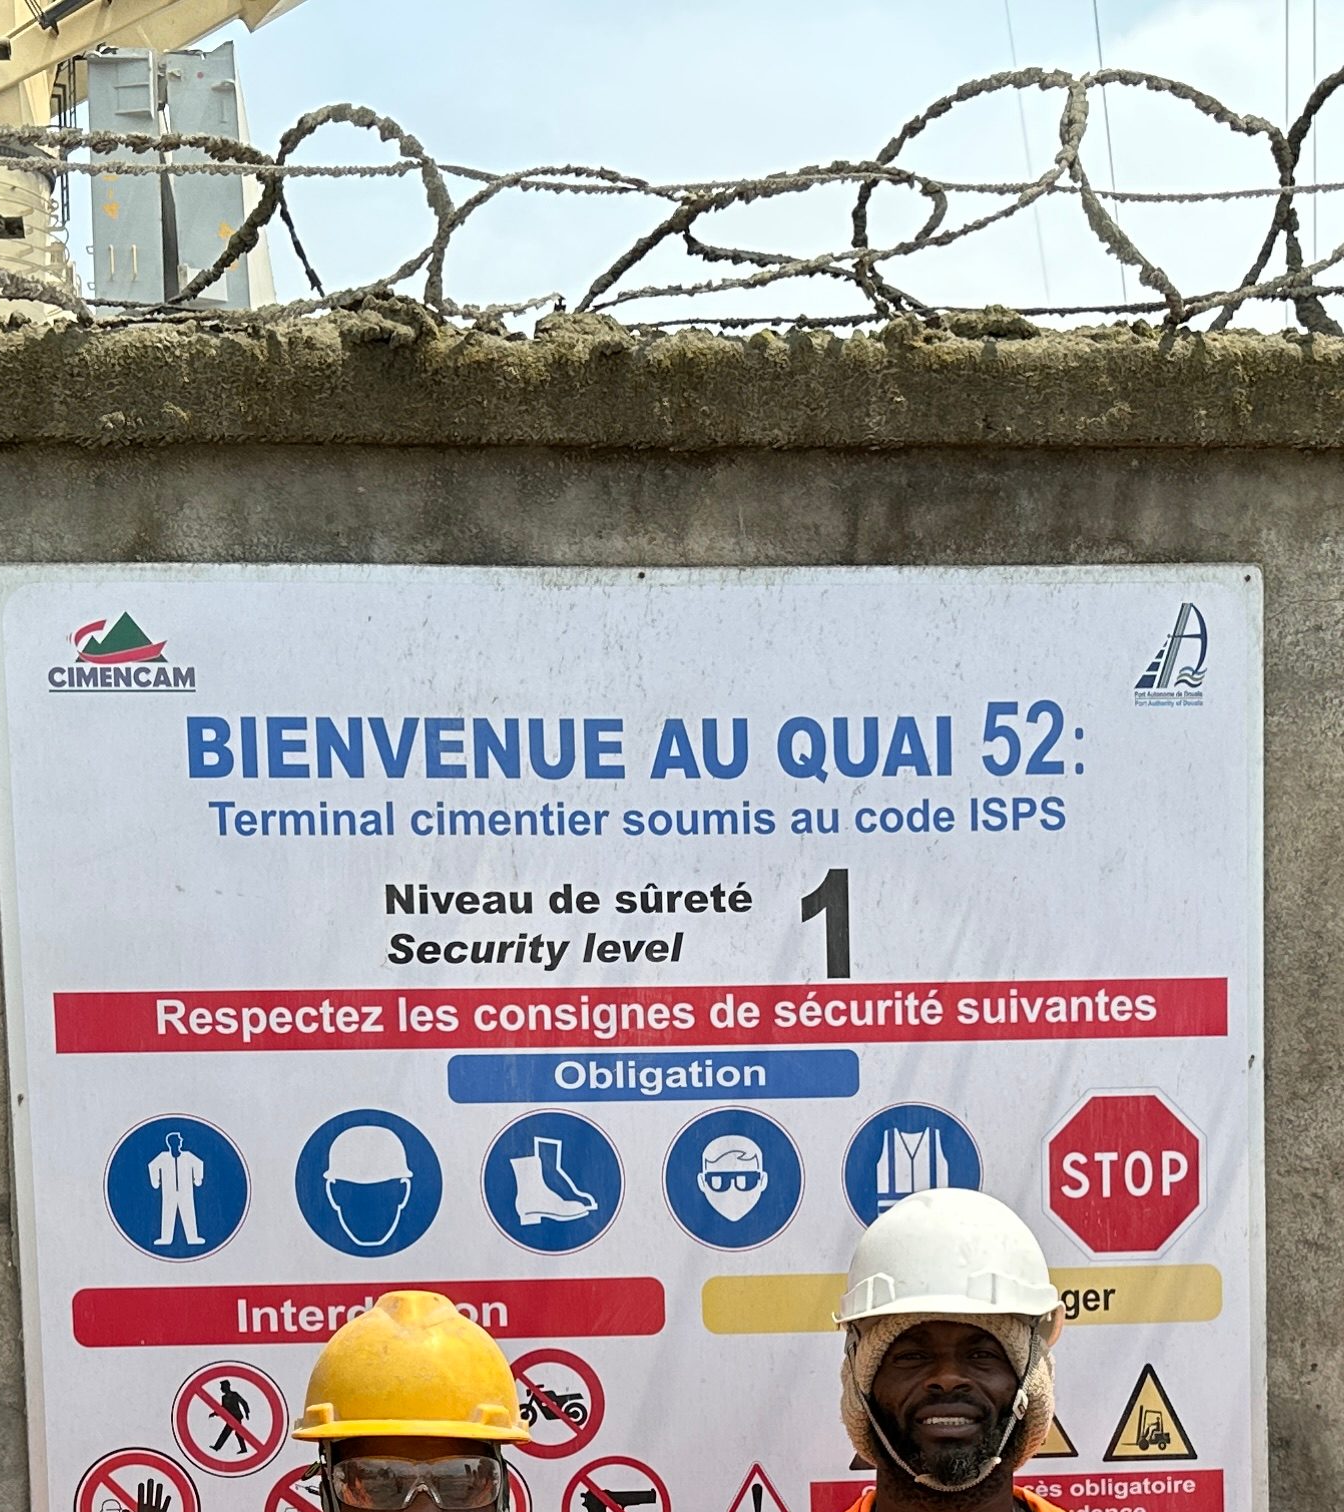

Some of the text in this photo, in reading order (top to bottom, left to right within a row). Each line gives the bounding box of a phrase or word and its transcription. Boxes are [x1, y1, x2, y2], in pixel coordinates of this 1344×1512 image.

[48, 666, 196, 688] CIMENCAM
[187, 699, 1084, 783] BIENVENUE AU QUAI 52:
[208, 796, 1067, 836] Terminal cimentier soumis au code ISPS
[385, 881, 753, 914] Niveau de sûreté
[801, 868, 850, 978] 1
[387, 931, 684, 971] Security level
[156, 988, 1157, 1042] Respectez les consignes de sécurité suivantes
[554, 1059, 766, 1096] Obligation
[1061, 1150, 1188, 1198] STOP
[1069, 1475, 1196, 1500] obligatoire
